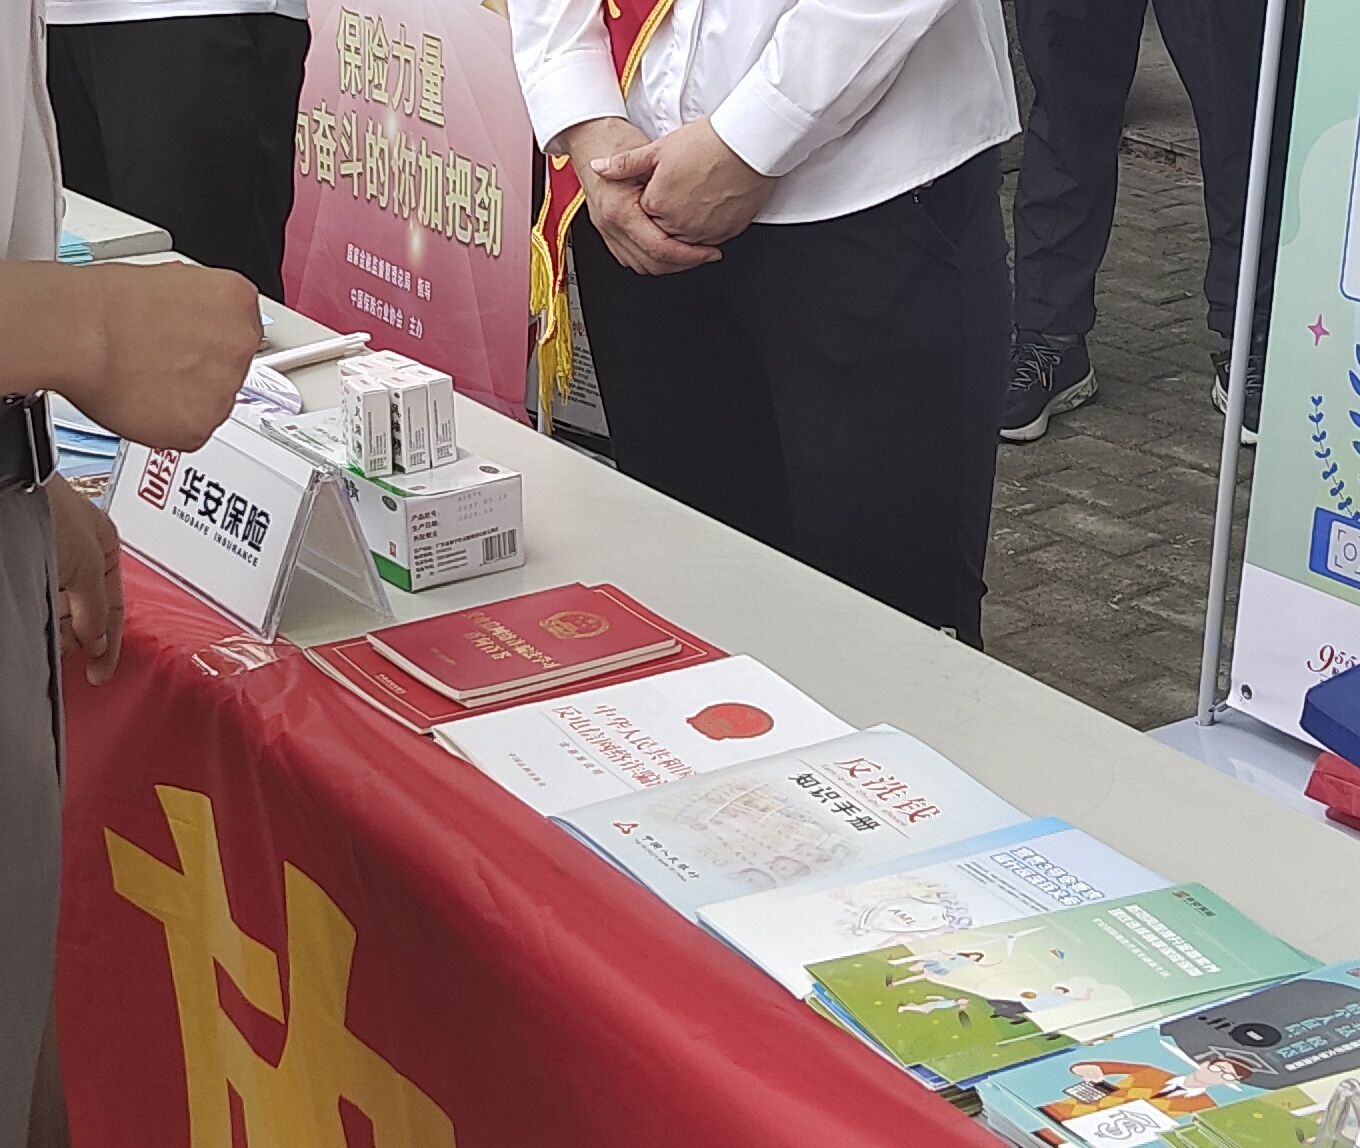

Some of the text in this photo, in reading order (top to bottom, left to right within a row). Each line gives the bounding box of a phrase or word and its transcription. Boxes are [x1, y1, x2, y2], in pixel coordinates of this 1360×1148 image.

[337, 5, 445, 128] 保险力量
[178, 466, 271, 553] 华安保险
[213, 531, 259, 567] INSURANCE
[788, 772, 881, 832] 知识手册
[834, 757, 940, 824] 反洗钱
